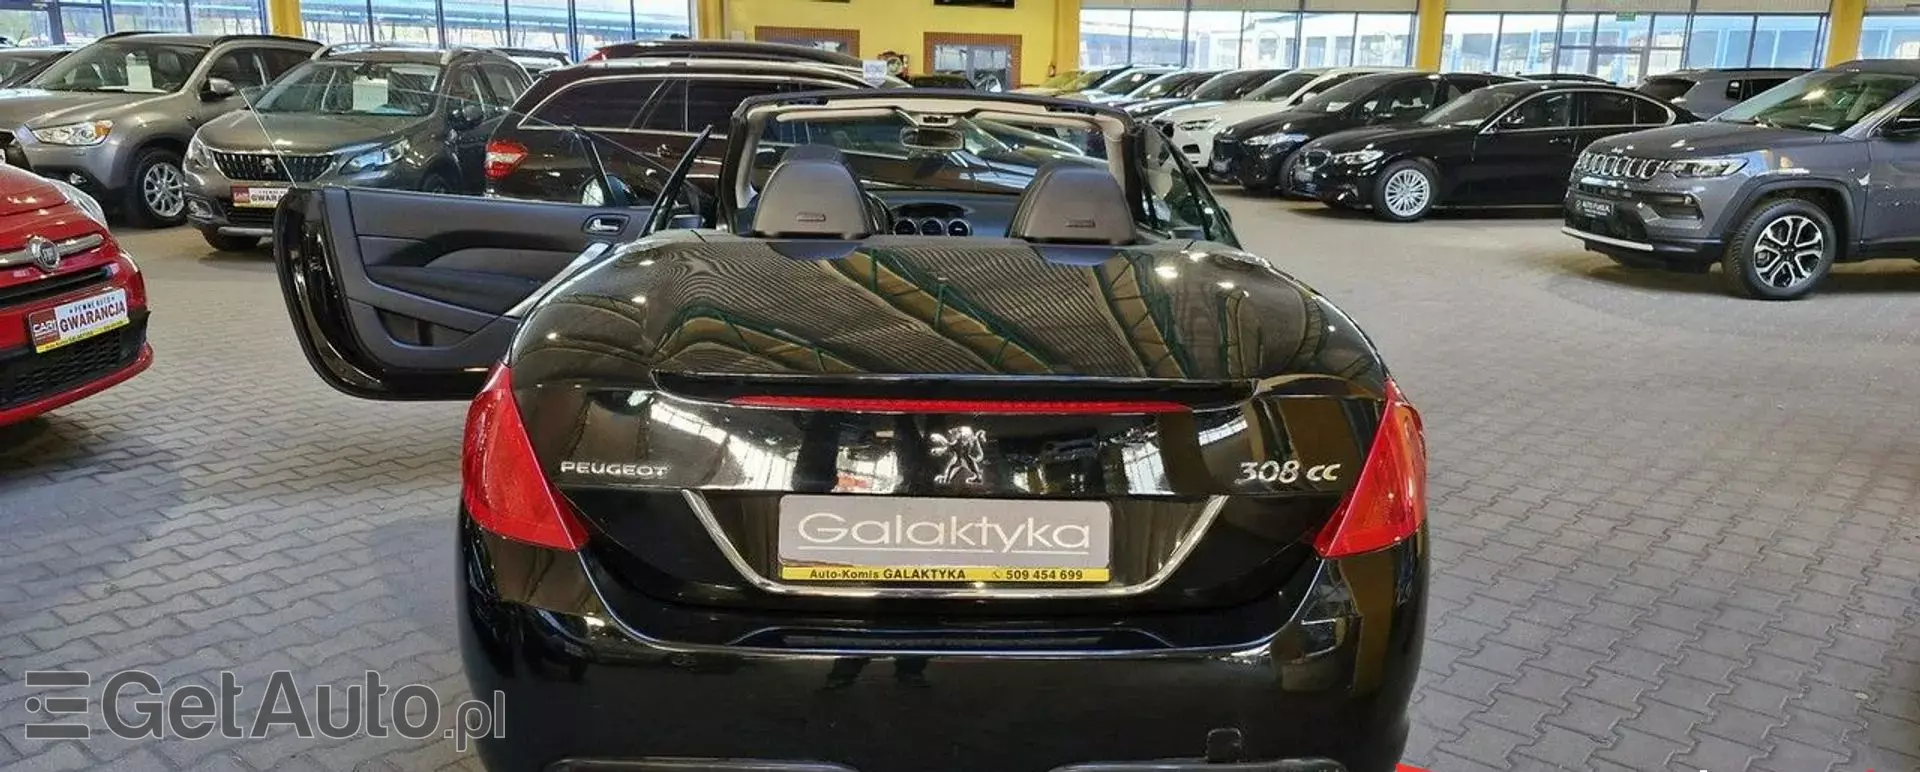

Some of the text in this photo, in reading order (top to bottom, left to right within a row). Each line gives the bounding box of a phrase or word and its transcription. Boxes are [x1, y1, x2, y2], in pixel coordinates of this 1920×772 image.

[60, 301, 126, 333] GWARANCJA
[560, 460, 669, 477] PEUGEOT
[1235, 460, 1300, 484] 308
[798, 512, 1090, 553] Galaktyka
[810, 568, 1083, 580] Auto-Komis GALAKTYKA 509 454 699
